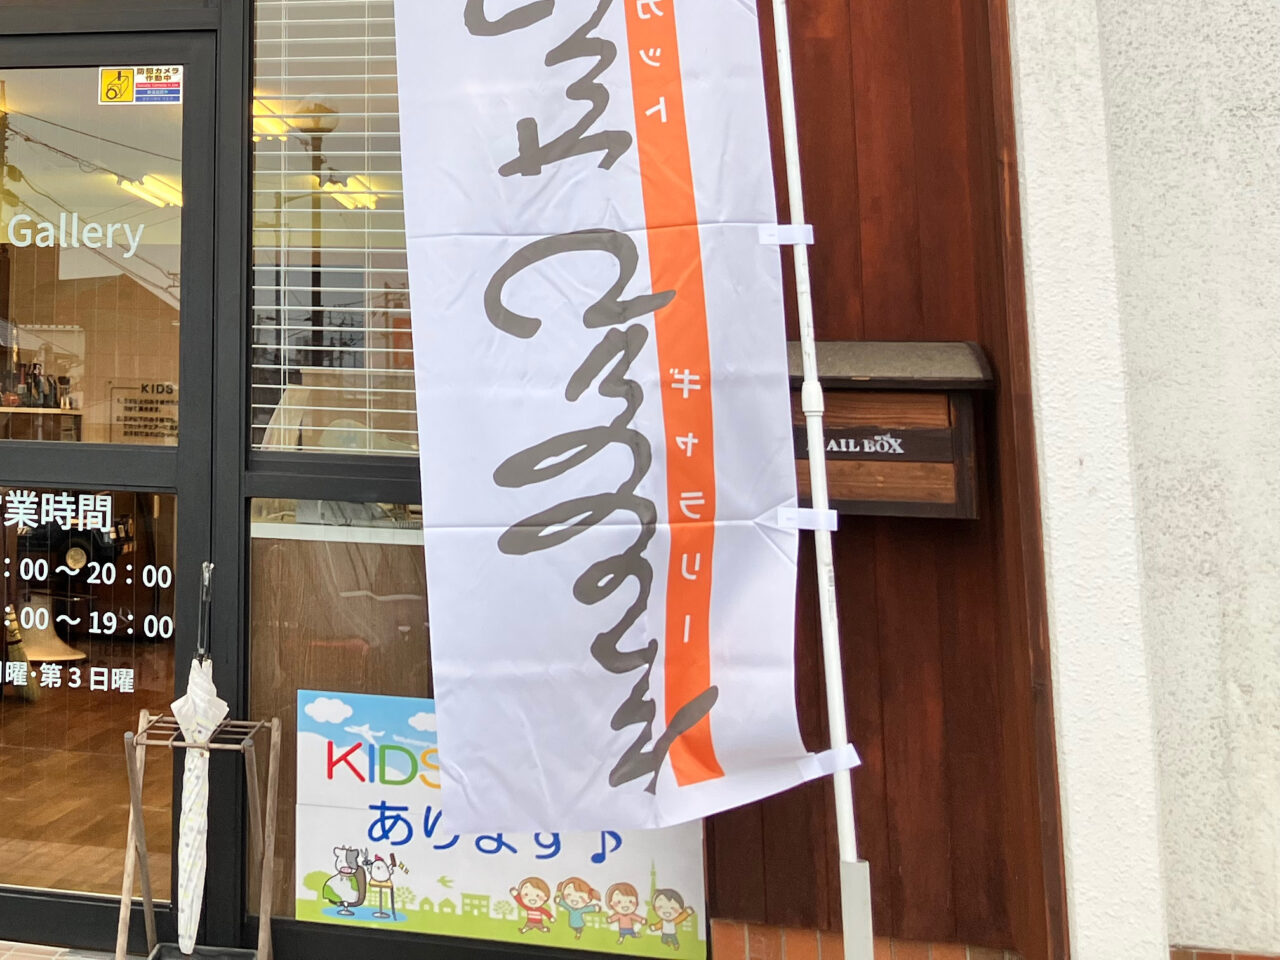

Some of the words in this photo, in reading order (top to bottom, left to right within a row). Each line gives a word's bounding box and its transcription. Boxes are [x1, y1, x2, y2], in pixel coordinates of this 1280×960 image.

[7, 212, 145, 259] Gallery
[141, 384, 174, 394] KIDS
[806, 438, 860, 452] AIL
[863, 437, 904, 454] BOX
[326, 740, 442, 789] KIDS
